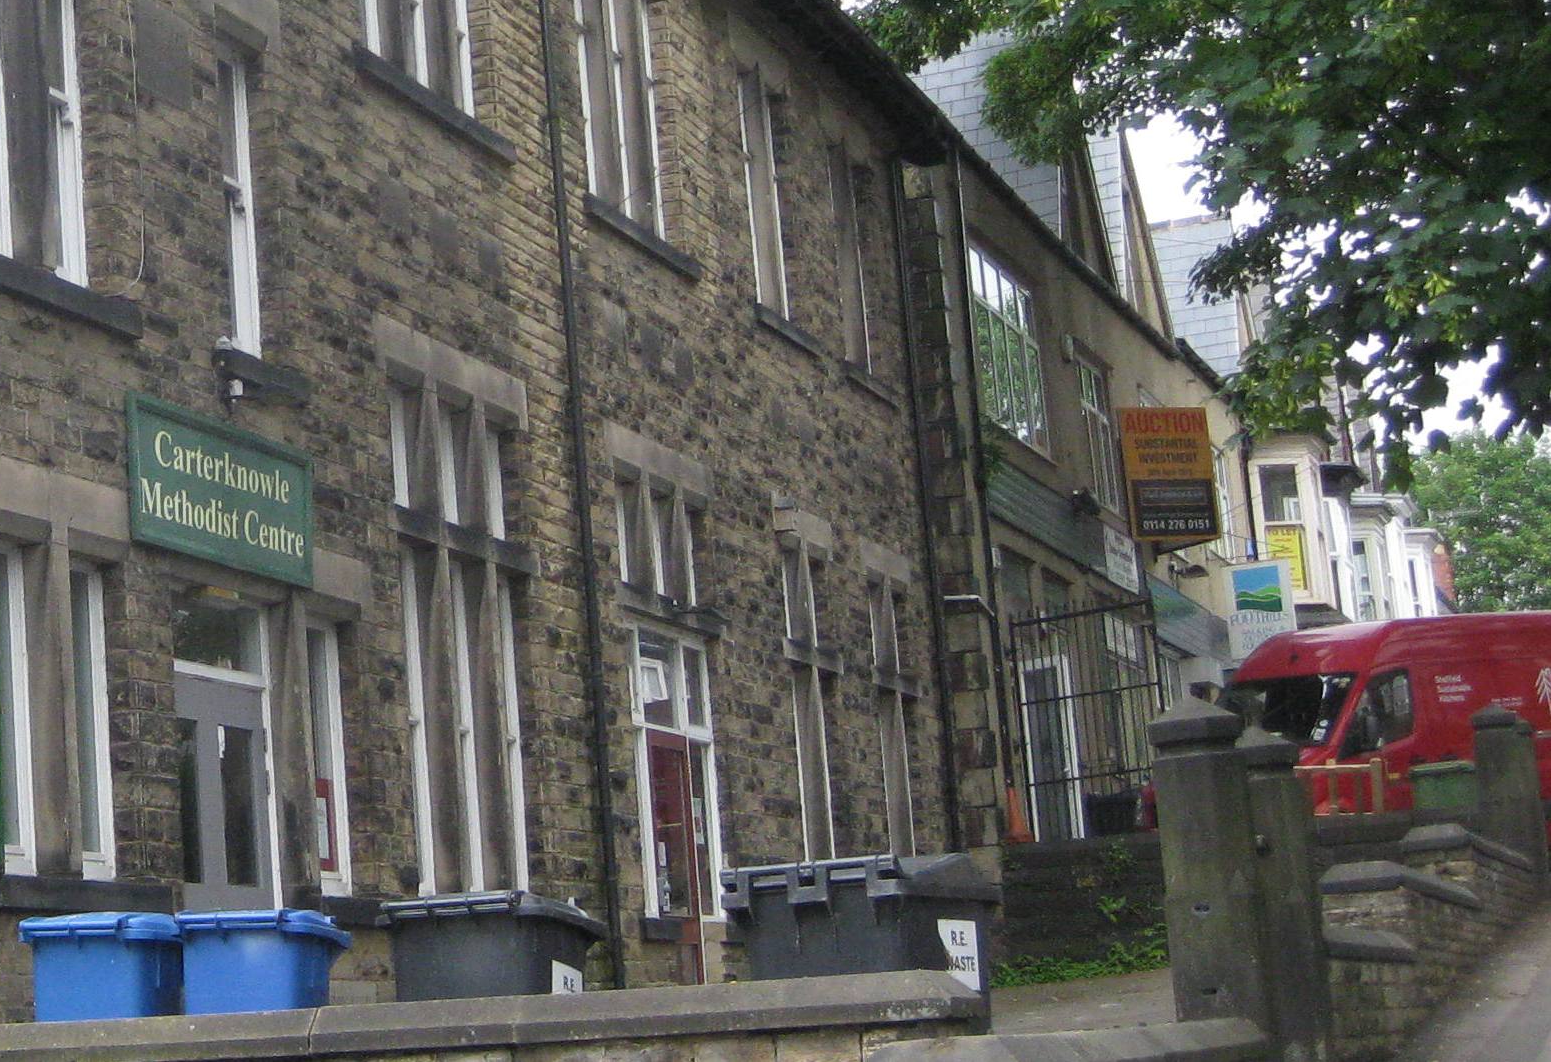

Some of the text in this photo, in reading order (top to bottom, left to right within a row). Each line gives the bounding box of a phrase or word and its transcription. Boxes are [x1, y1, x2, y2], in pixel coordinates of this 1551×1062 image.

[1126, 412, 1205, 433] AUCTION
[1135, 438, 1199, 450] SUBSTANTIAL
[1137, 452, 1197, 464] INVESTMENT
[154, 430, 290, 504] Carterknowle
[140, 477, 305, 558] Methodist Centre
[1142, 519, 1210, 530] 0114 276 0151
